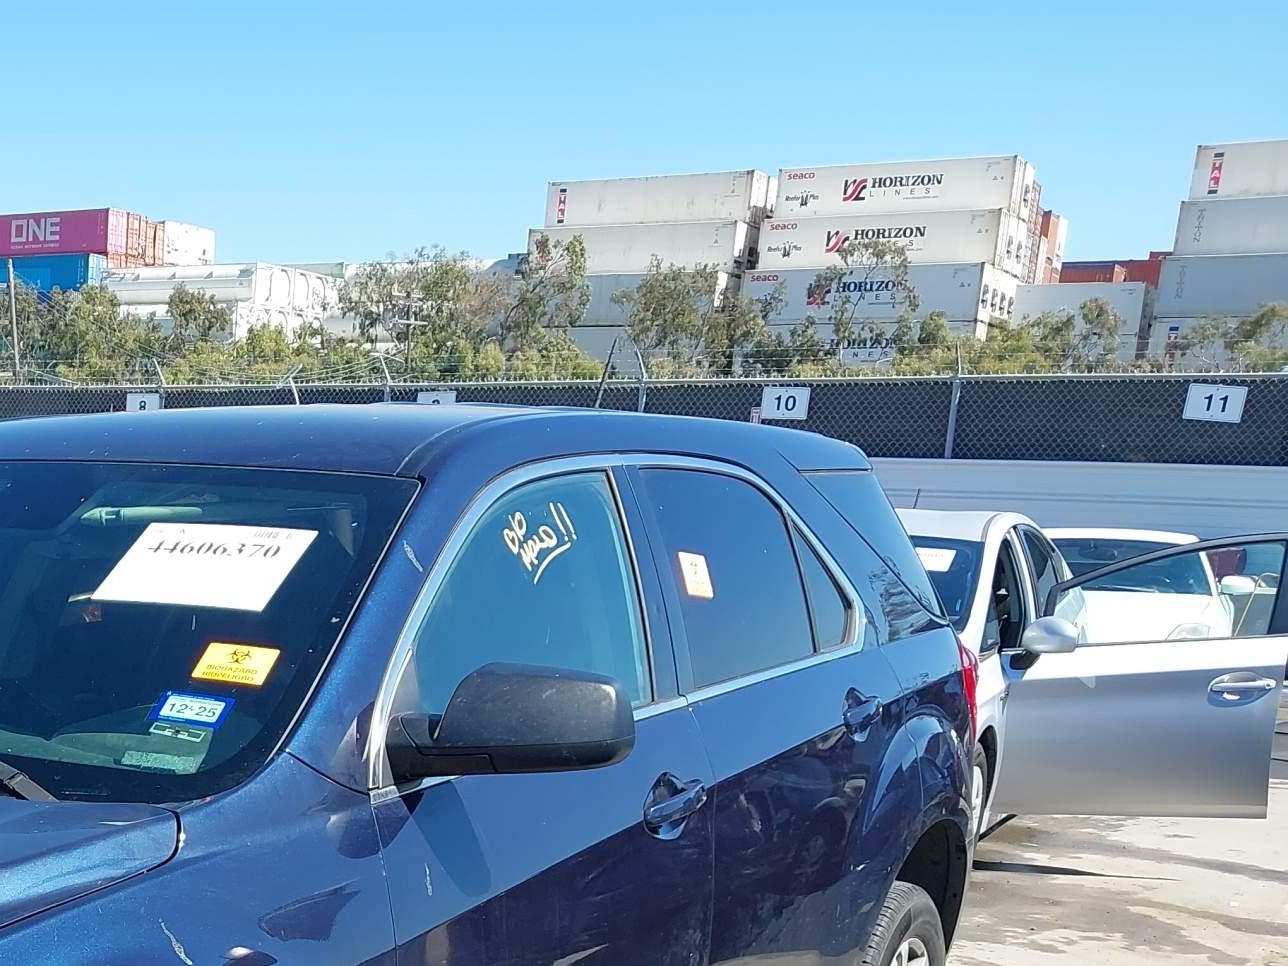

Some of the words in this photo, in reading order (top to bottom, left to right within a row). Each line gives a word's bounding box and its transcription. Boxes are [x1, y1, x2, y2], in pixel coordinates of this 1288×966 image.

[787, 172, 815, 180] seaco
[870, 173, 944, 188] HORIZON
[869, 187, 931, 198] LINES
[11, 217, 61, 242] ONE
[769, 223, 798, 231] seaco
[853, 226, 927, 241] HORIZON
[751, 274, 779, 282] seaco
[834, 279, 909, 293] HORIZON
[833, 293, 897, 302] LNES
[138, 400, 147, 411] 8
[774, 394, 797, 412] 10
[1204, 393, 1229, 413] 11
[147, 540, 281, 559] 44606370
[201, 670, 255, 682] BIOPELIGRO
[205, 664, 259, 675] BIOHAZARD
[167, 702, 188, 715] 12
[198, 705, 219, 719] 25
